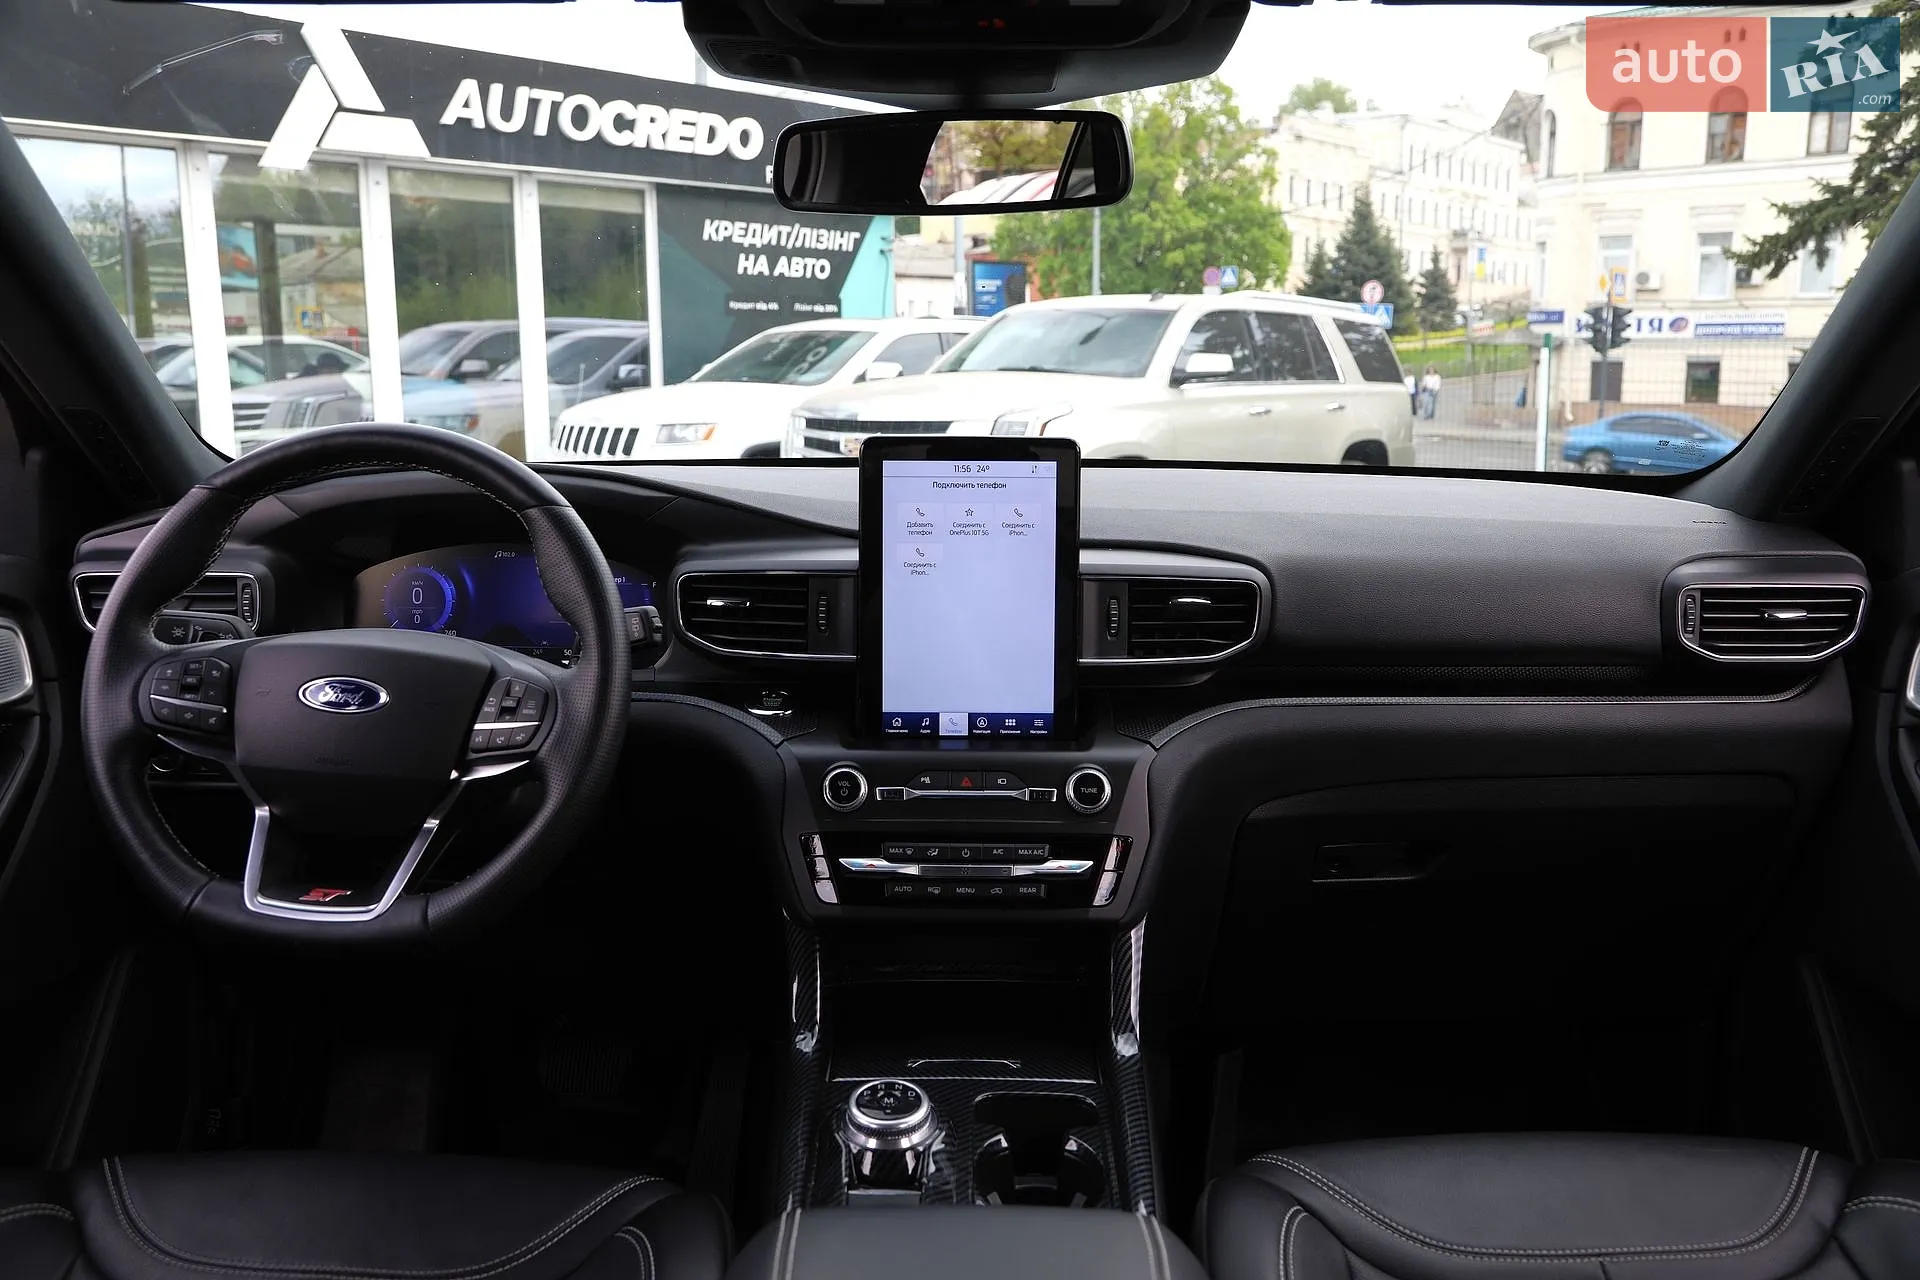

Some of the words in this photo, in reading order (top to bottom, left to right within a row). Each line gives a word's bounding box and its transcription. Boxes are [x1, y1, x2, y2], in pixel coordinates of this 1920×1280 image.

[439, 78, 765, 161] AUTOCREDO
[702, 218, 861, 252] КРЕДИТ/ЛІЗІНГ
[737, 253, 770, 276] НА
[773, 255, 831, 280] АВТО
[954, 464, 971, 473] 11:56
[932, 481, 975, 489] Подключить
[977, 482, 1007, 490] телефон
[952, 521, 982, 529] Соединить
[412, 587, 423, 605] 0
[414, 614, 421, 624] 0
